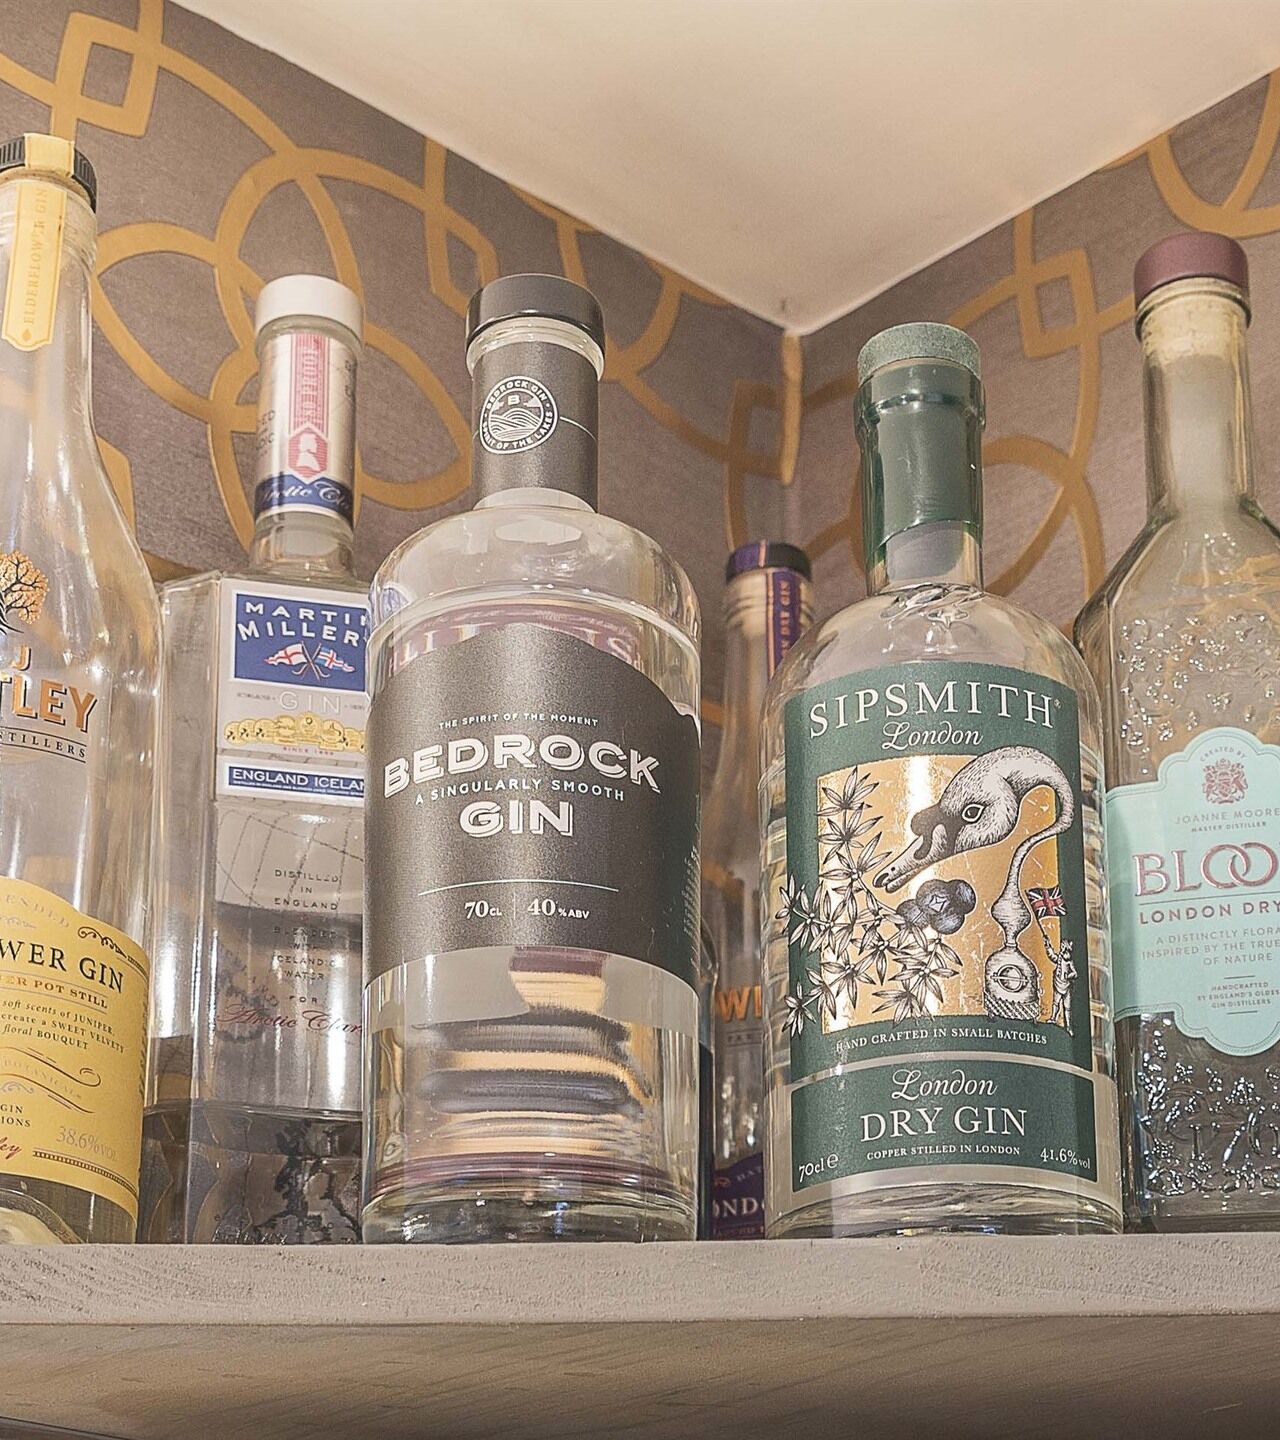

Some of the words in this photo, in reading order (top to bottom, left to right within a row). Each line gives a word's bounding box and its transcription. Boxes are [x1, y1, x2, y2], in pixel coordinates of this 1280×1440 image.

[486, 380, 529, 410] BEDROCK
[530, 382, 548, 401] GIN
[496, 441, 509, 450] OF
[512, 435, 534, 449] THE
[534, 411, 553, 440] LAKES
[279, 691, 340, 714] GIN
[809, 681, 1054, 739] SIPSMITH
[438, 720, 458, 730] THE
[462, 714, 499, 725] SPIRIT
[503, 713, 520, 722] OF
[523, 713, 545, 722] THE
[550, 714, 599, 727] MOMENT
[882, 721, 983, 751] London
[232, 768, 309, 786] ENGLAND
[384, 734, 661, 798] BEDROCK
[415, 793, 425, 806] A
[430, 779, 542, 801] SINGULARLY
[551, 780, 625, 802] SMOOTH
[460, 800, 573, 837] GIN
[1176, 812, 1229, 825] JOANNE
[1140, 902, 1232, 925] LONDON
[1156, 935, 1164, 945] A
[1168, 928, 1239, 944] DISTINCTLY
[79, 956, 124, 994] GIN
[836, 1036, 867, 1053] HAND
[871, 1028, 929, 1046] CRAFTED
[933, 1028, 947, 1037] IN
[951, 1028, 993, 1038] SMALL
[997, 1029, 1048, 1045] BATCHES
[891, 1069, 998, 1101] London
[0, 1102, 24, 1114] GIN
[860, 1108, 943, 1142] DRY
[954, 1106, 1028, 1137] GIN
[866, 1147, 907, 1161] COPPER
[911, 1145, 957, 1156] STILLED
[960, 1145, 972, 1154] IN
[974, 1145, 1020, 1156] LONDON
